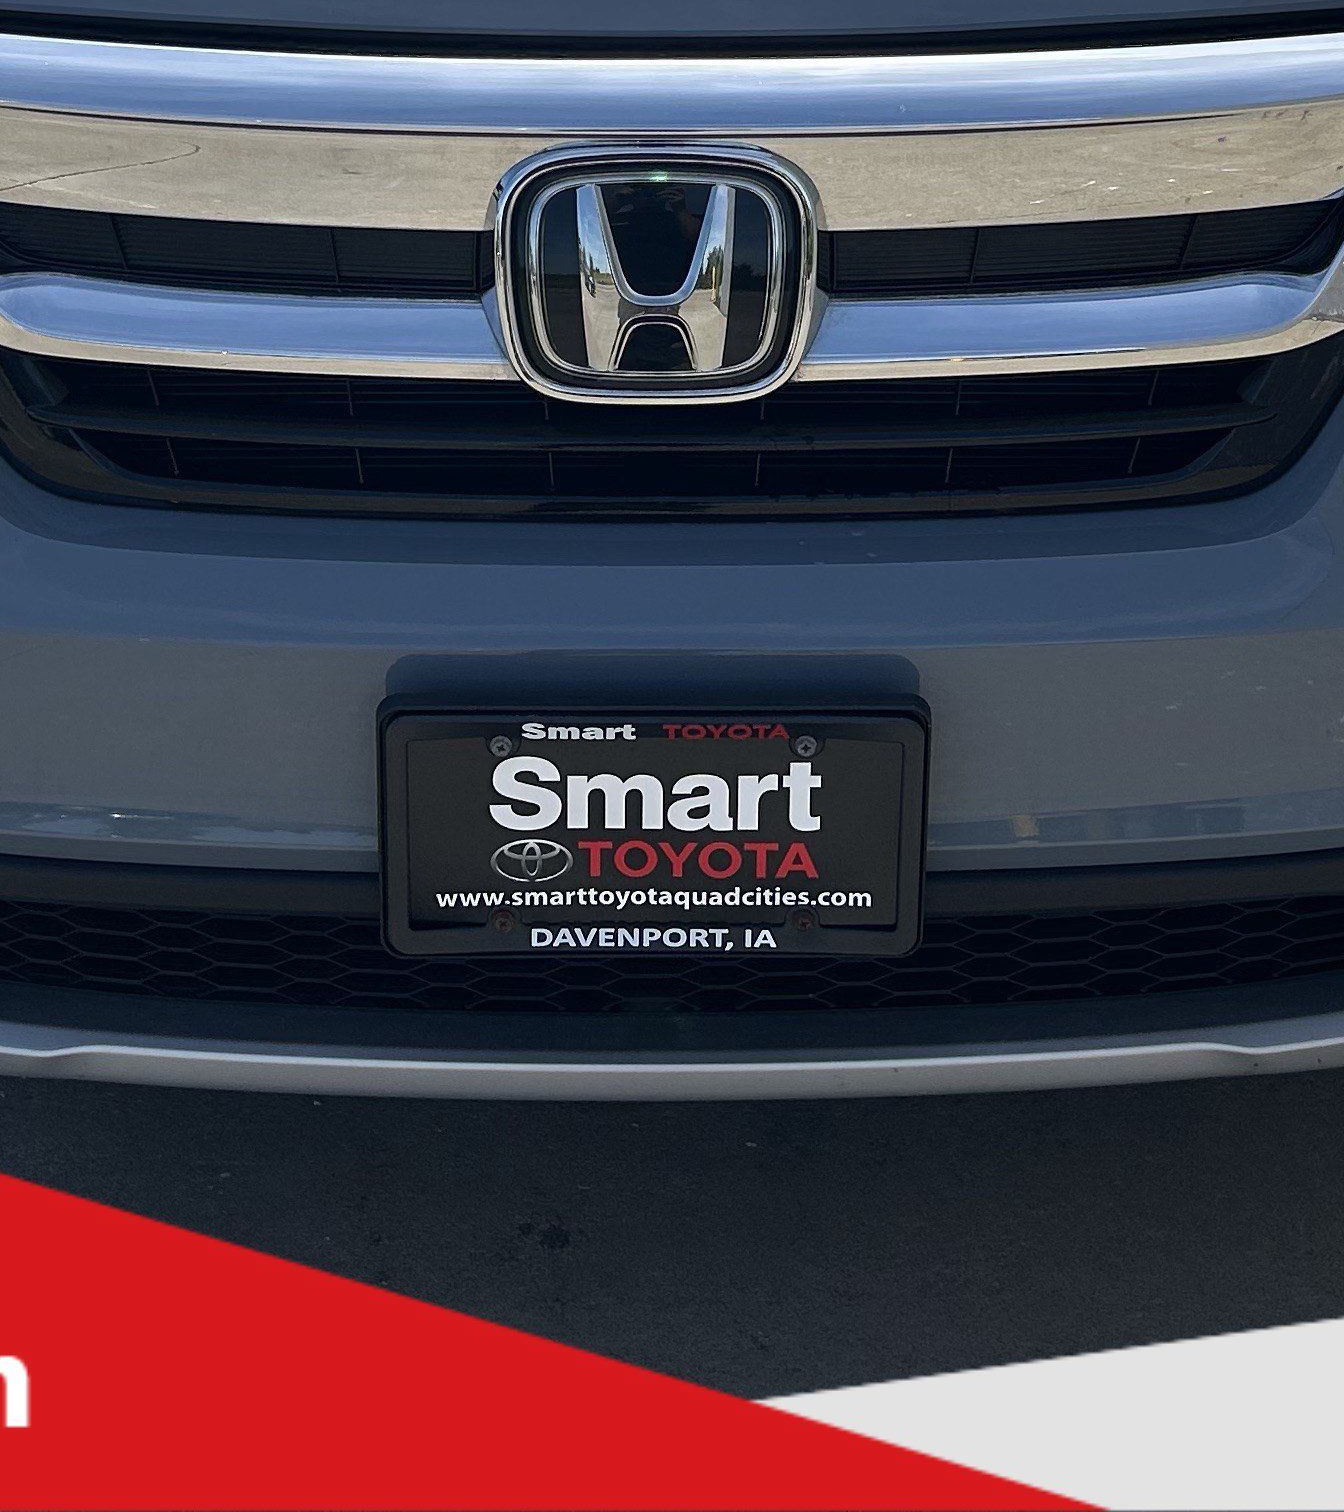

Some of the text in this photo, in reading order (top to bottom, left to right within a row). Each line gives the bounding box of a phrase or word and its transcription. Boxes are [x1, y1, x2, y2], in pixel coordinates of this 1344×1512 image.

[522, 722, 790, 741] Smart TOYOTA
[489, 756, 822, 832] Smart
[577, 839, 820, 879] TOYOTA
[435, 886, 873, 910] www.smarttoyotaquadcities.com
[530, 927, 777, 952] DAVENPORT, IA
